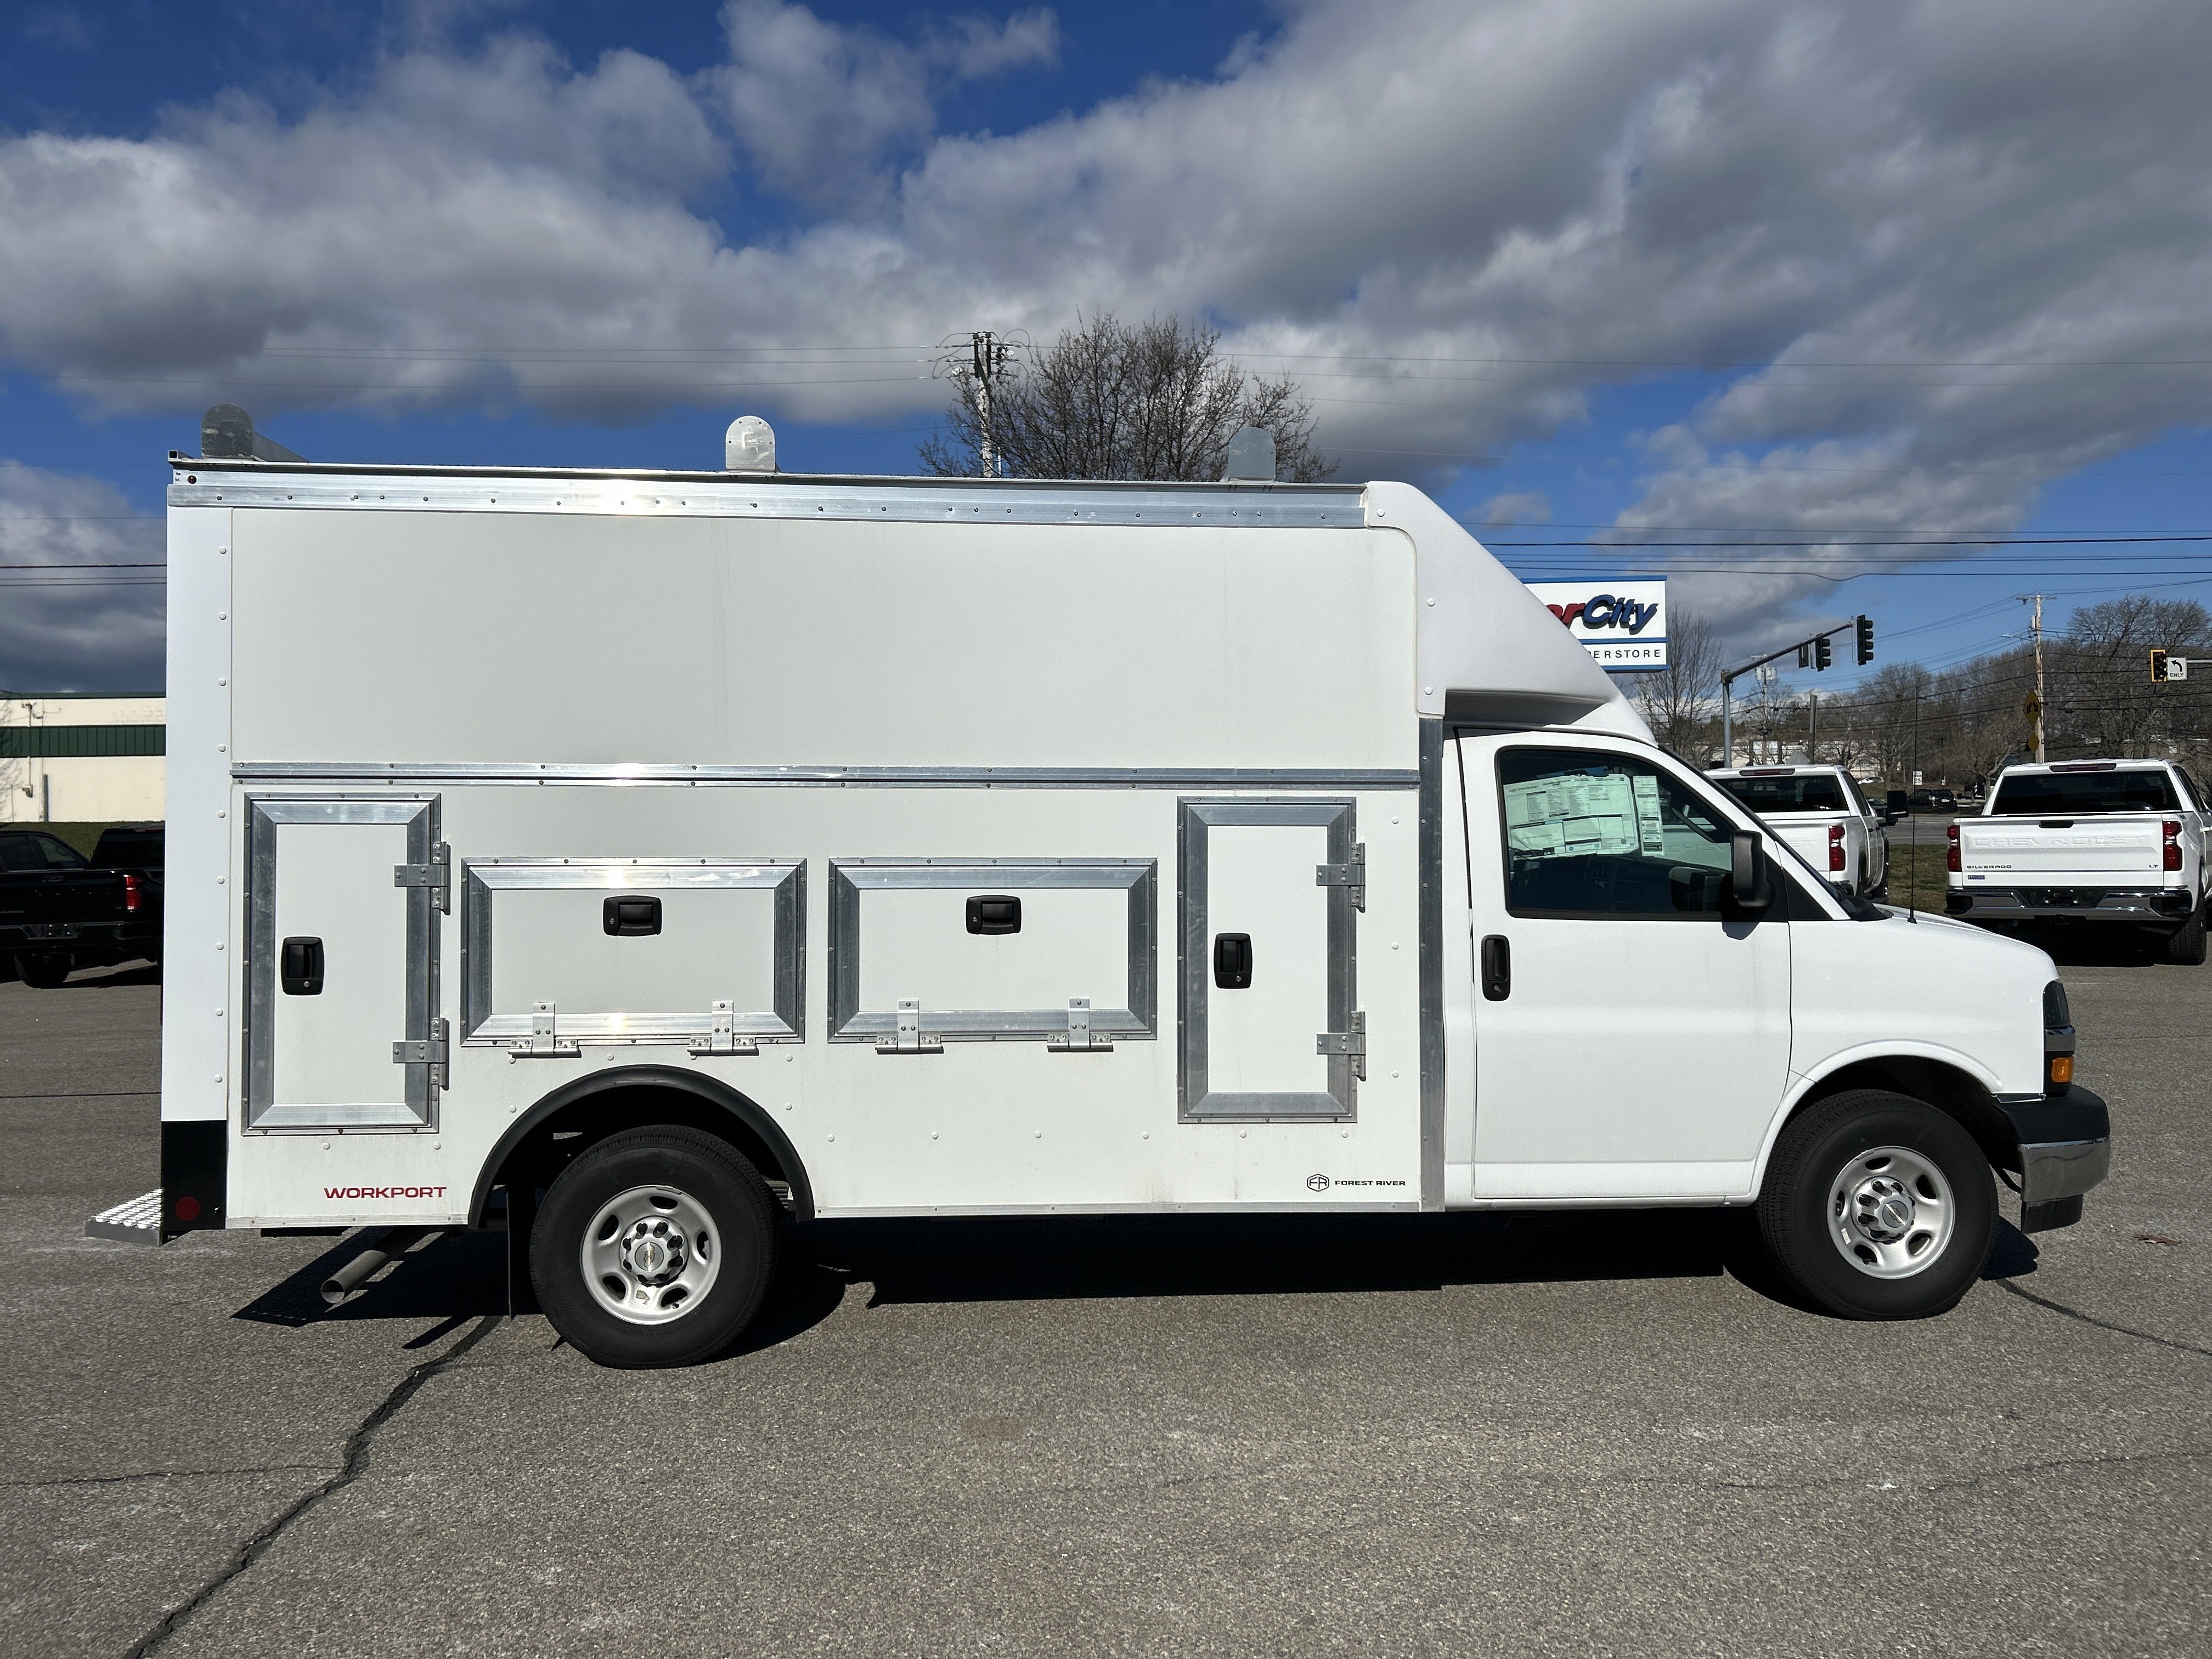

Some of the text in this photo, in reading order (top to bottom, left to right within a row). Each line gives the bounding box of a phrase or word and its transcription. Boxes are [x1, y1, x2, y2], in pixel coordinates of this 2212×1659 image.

[1589, 650, 1661, 658] ERSTORE
[1973, 837, 2147, 847] CHEVROLET
[324, 1187, 447, 1199] WORKPORT
